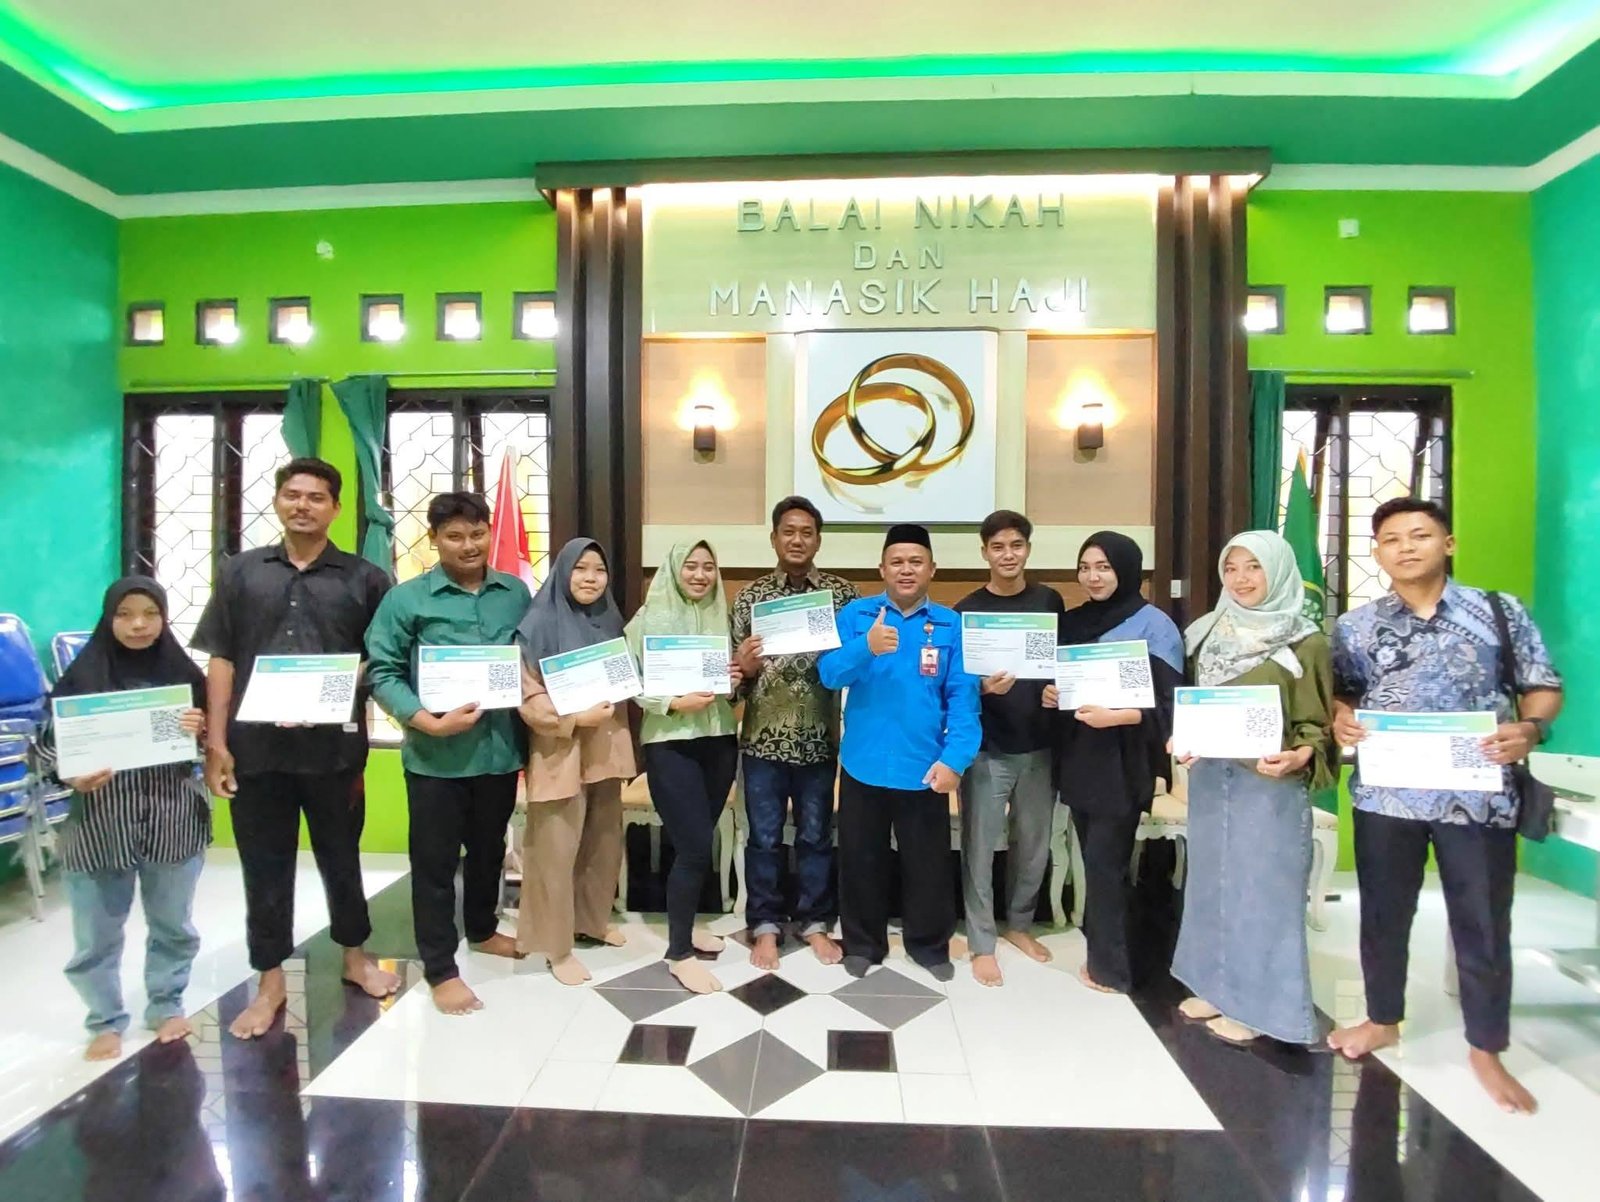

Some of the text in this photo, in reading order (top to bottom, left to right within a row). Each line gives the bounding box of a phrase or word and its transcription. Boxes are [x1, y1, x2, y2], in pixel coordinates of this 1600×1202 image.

[737, 193, 1064, 232] BALAI NIKAH
[853, 241, 943, 270] DAN
[709, 276, 1088, 316] MANASIK HAJI
